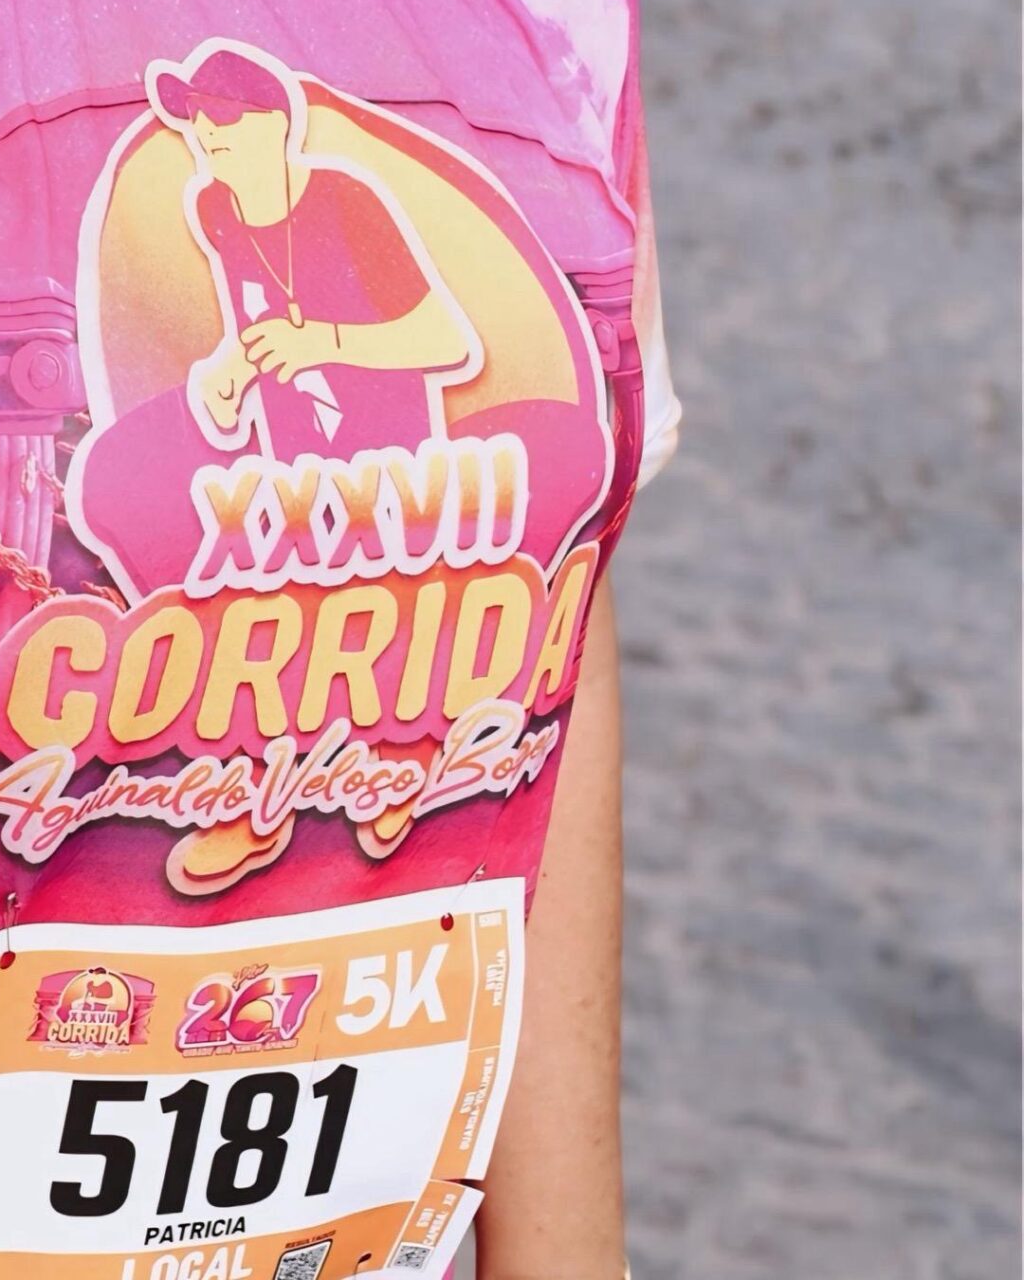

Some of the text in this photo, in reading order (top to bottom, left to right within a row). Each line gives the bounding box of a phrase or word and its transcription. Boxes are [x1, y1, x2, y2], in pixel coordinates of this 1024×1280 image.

[201, 447, 518, 578] XXXVII
[7, 560, 589, 748] CORRIDA
[258, 725, 419, 826] Veloso
[47, 1022, 131, 1046] CORRIDA
[70, 1011, 116, 1024] XXXVII
[180, 970, 319, 1045] 267
[333, 942, 451, 1037] 5K
[48, 1063, 359, 1218] 5181
[144, 1216, 247, 1246] PATRICIA
